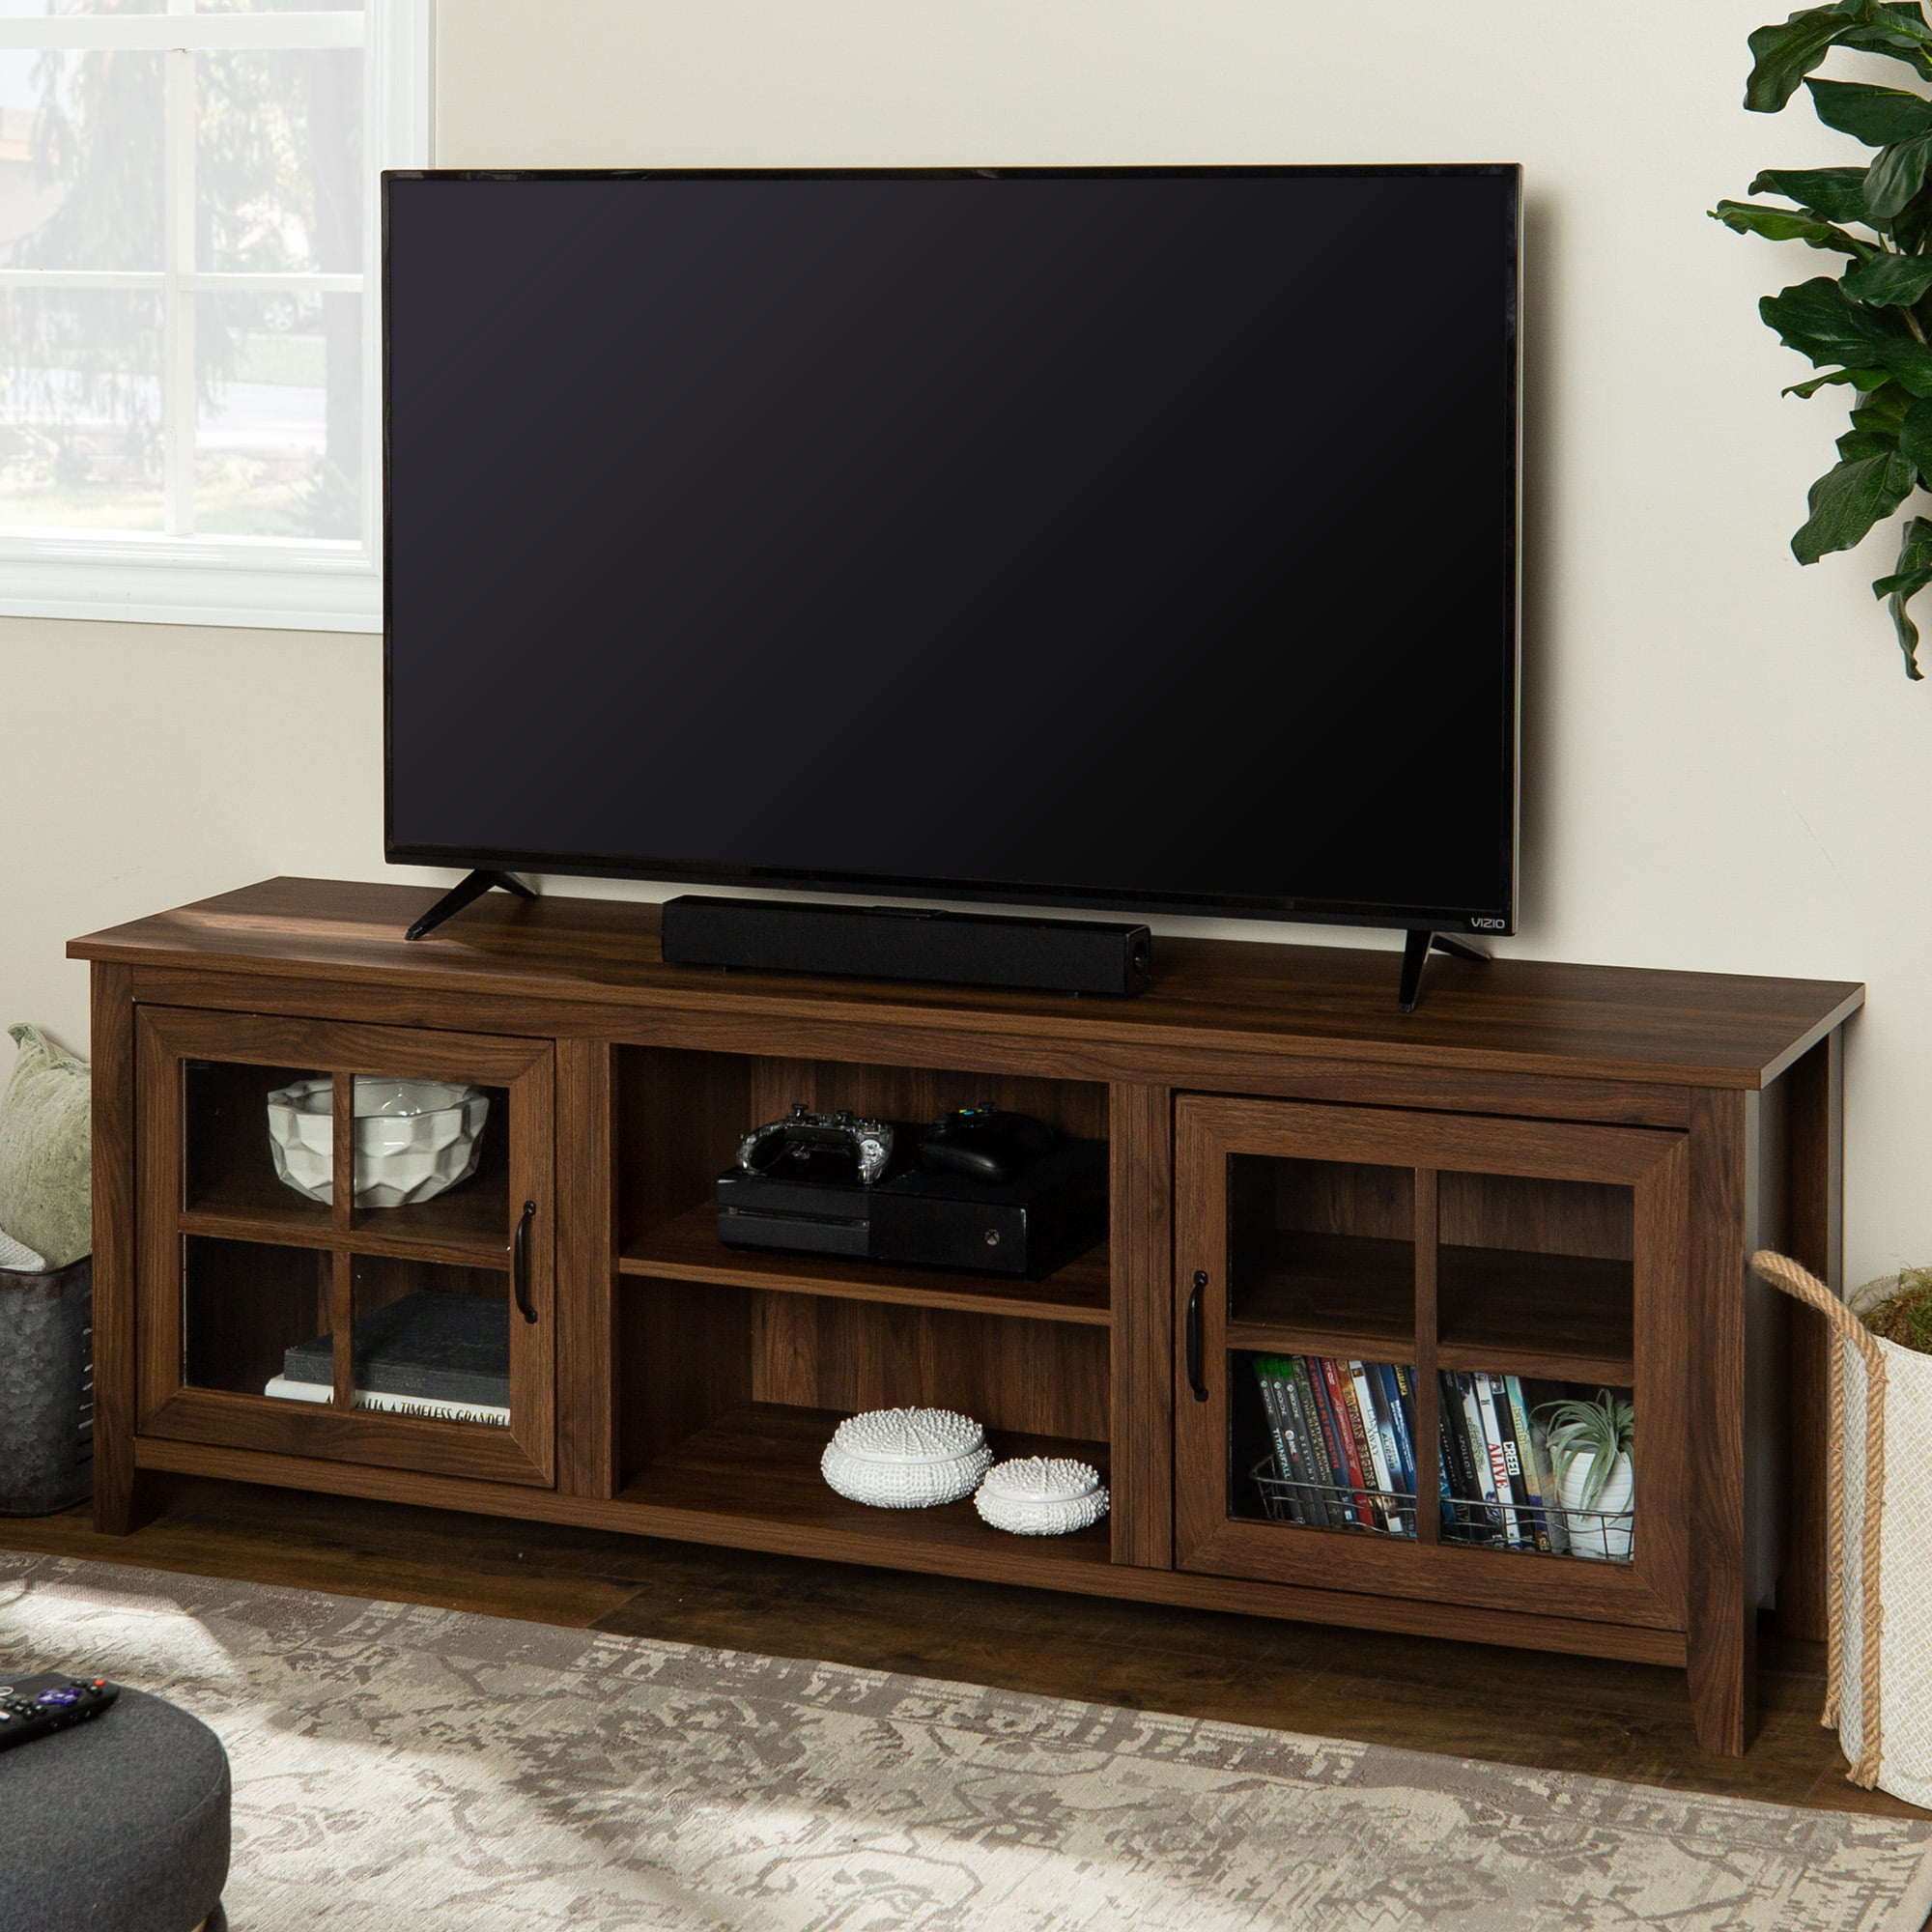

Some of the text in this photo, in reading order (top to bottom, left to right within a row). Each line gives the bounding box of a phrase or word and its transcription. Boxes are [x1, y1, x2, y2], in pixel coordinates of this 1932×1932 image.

[1471, 917, 1505, 928] VIZIO
[1272, 1427, 1292, 1480] TITANFALL
[1299, 1435, 1315, 1482] DESTINY
[1324, 1426, 1340, 1468] DETECTIVE
[1344, 1389, 1364, 1440] BATMAN
[1356, 1443, 1376, 1489] BEGINS
[1366, 1427, 1378, 1457] AWAY
[1458, 1434, 1470, 1466] APOLLO
[1502, 1440, 1520, 1476] CREED
[1488, 1443, 1509, 1490] ALIVE
